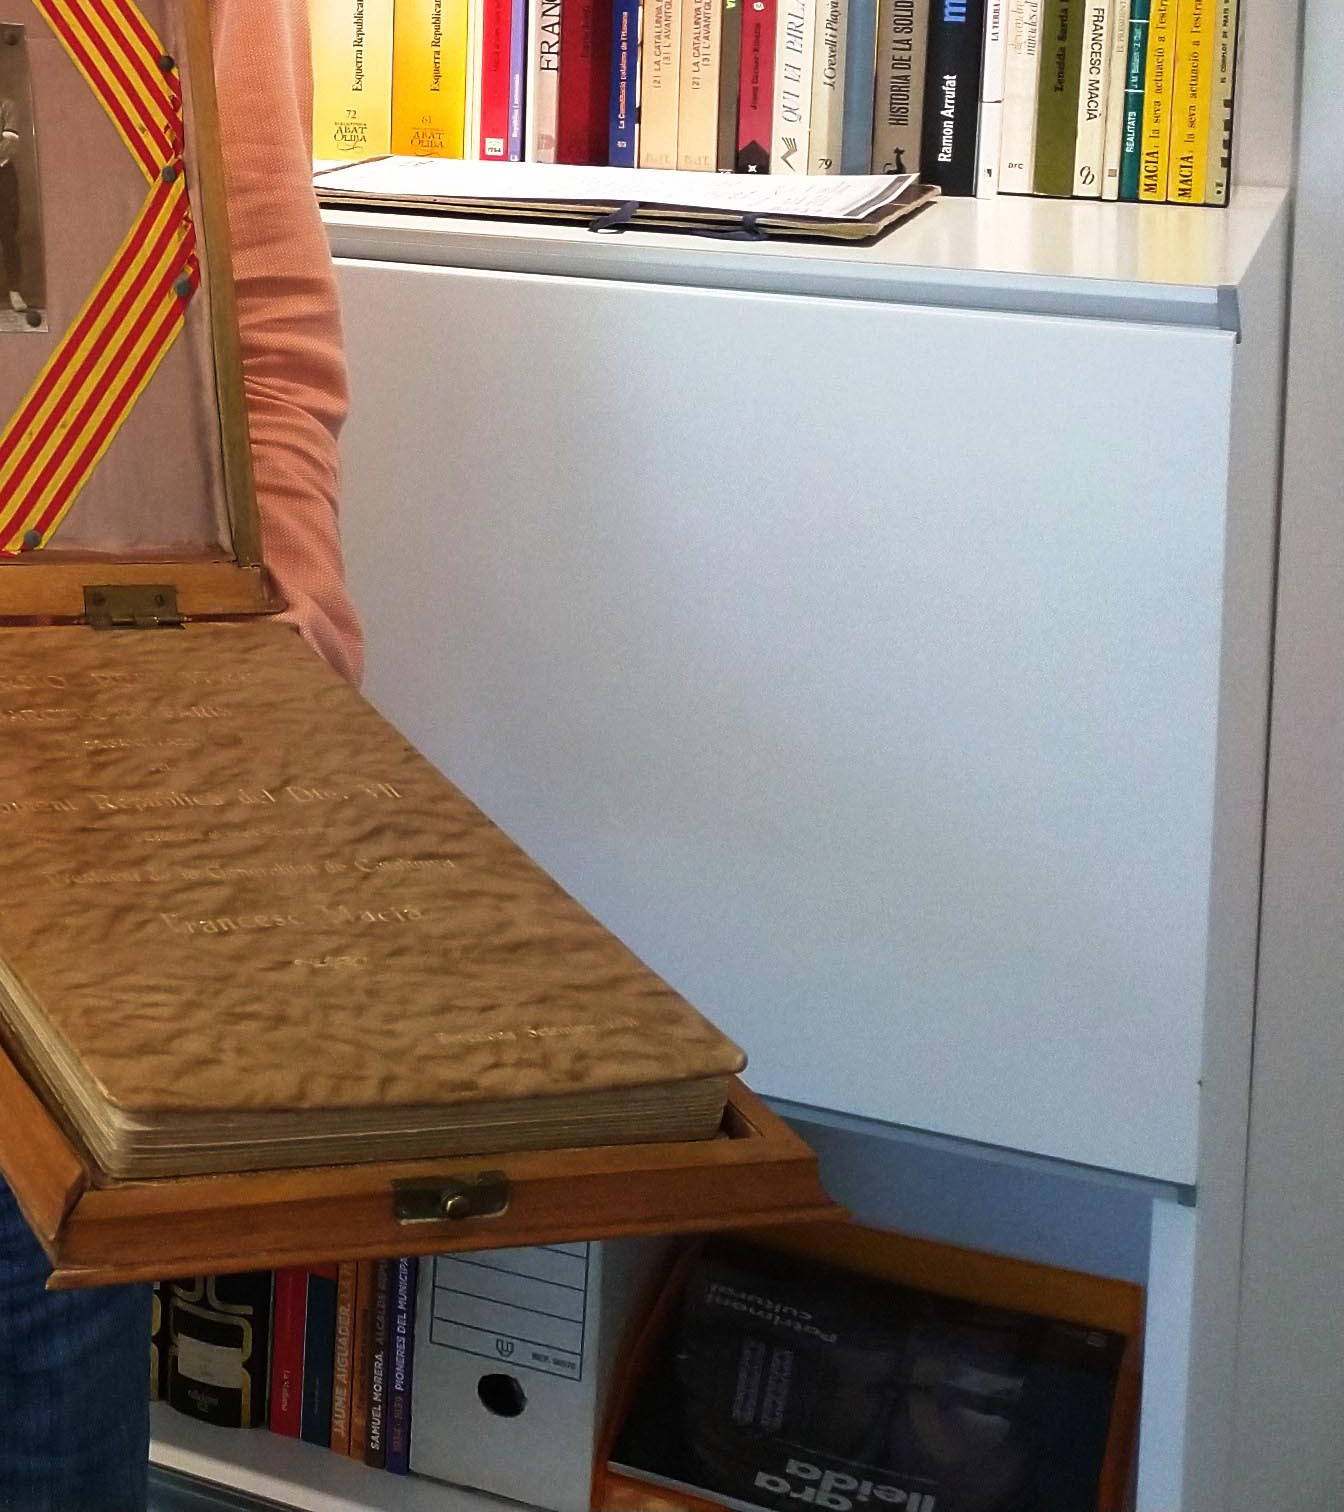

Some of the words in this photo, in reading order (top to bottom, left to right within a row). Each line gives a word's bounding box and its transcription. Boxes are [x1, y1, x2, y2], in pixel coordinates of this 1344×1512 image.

[655, 4, 665, 56] CATALUNYA
[693, 5, 703, 57] CATALUNYA
[893, 37, 912, 51] LA
[1088, 8, 1105, 75] FRANCESC
[352, 50, 365, 92] Esquerra
[430, 50, 443, 92] Esquerra
[654, 60, 663, 71] LA
[692, 61, 701, 73] LA
[824, 40, 838, 81] Crexell
[892, 54, 911, 70] DE
[1153, 47, 1165, 94] actuació
[1188, 52, 1201, 99] actuació
[345, 108, 357, 120] 72
[781, 93, 801, 123] QUI
[887, 75, 910, 126] HISTORIA
[940, 75, 957, 118] Arrufat
[1086, 79, 1102, 121] MACIÀ
[1152, 100, 1161, 123] seva
[1187, 105, 1196, 129] seva
[938, 121, 954, 162] Ramon
[1126, 112, 1136, 153] REALITATS
[1149, 128, 1160, 139] la
[1185, 133, 1195, 143] la
[817, 158, 833, 170] 79
[335, 1304, 350, 1384] AIGUADER.
[397, 1313, 406, 1333] DEL
[373, 1351, 383, 1401] MORERA.
[395, 1336, 405, 1391] PIONERES
[333, 1387, 347, 1436] JAUME
[371, 1404, 382, 1450] SAMUEL
[753, 1470, 853, 1512] gra
[785, 1458, 936, 1512] lleida
